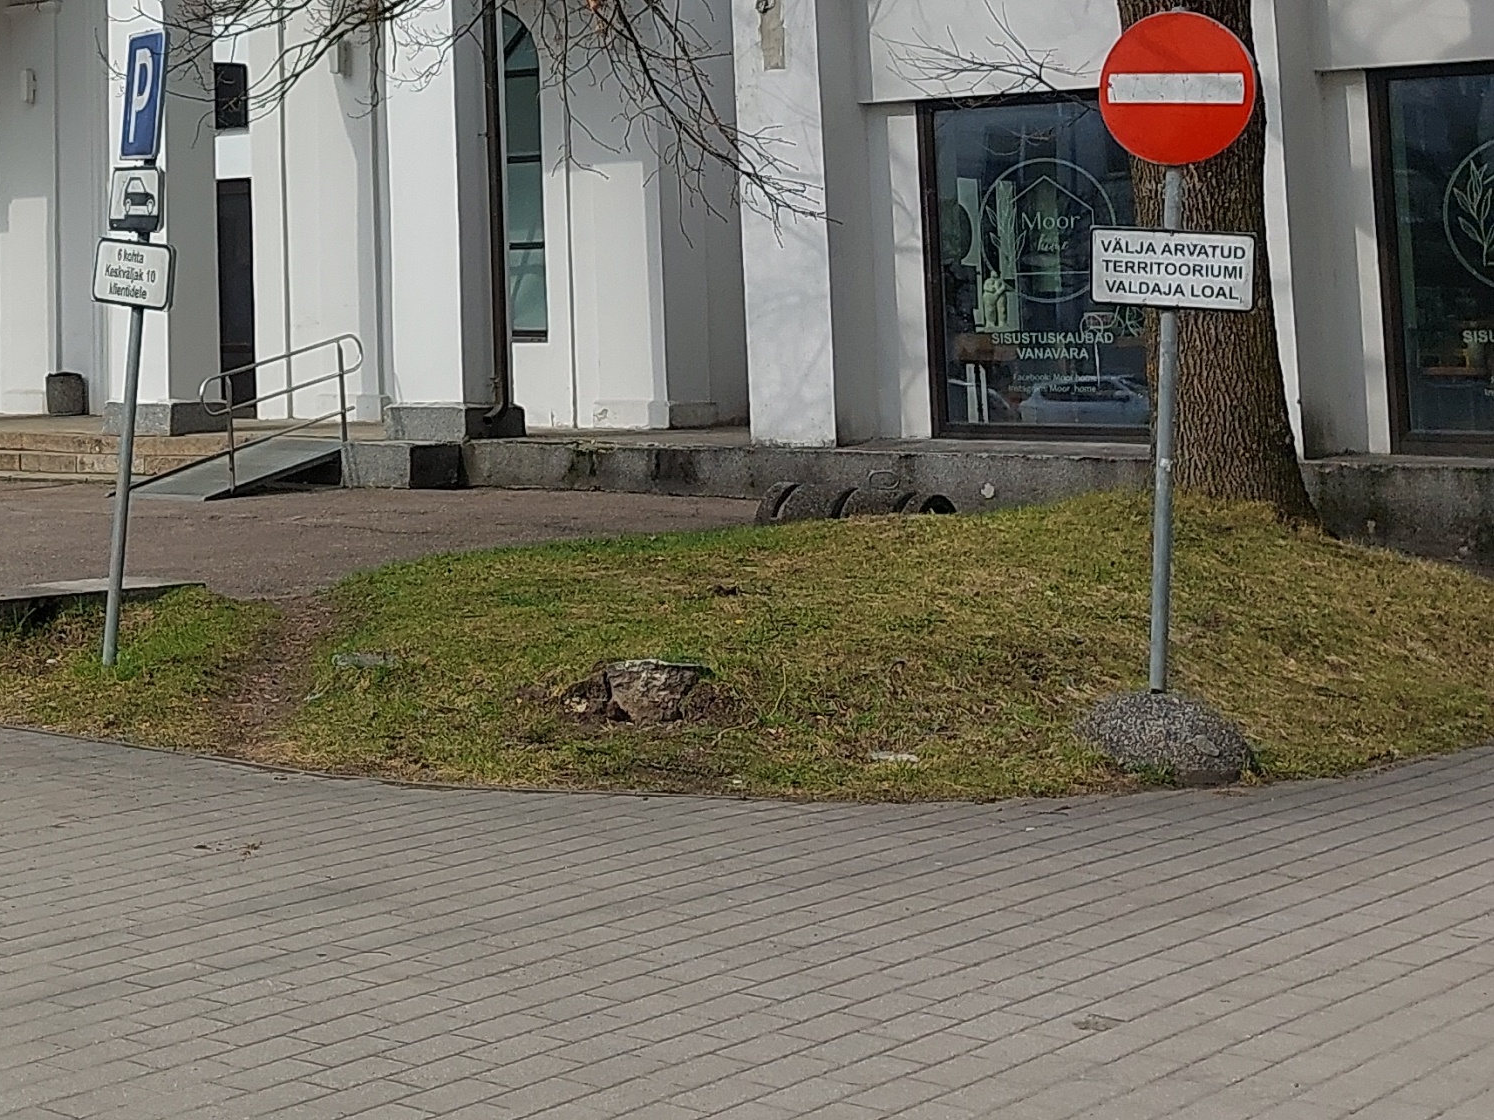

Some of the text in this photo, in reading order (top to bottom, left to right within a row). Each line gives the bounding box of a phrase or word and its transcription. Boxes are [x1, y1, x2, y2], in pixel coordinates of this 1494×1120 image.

[128, 48, 153, 143] P
[1022, 211, 1081, 230] Moor
[117, 249, 144, 264] 6 kohta
[1101, 237, 1246, 260] VÄLJA ARVATUD
[105, 264, 156, 284] Keskväljak 10
[1102, 259, 1243, 280] TERRITOORIUMI
[108, 282, 147, 299] klientidele
[1105, 280, 1239, 300] VALDAJA LOAL
[991, 332, 1114, 345] SISUSTUSKAUBAD
[1017, 347, 1089, 360] VANAVARA
